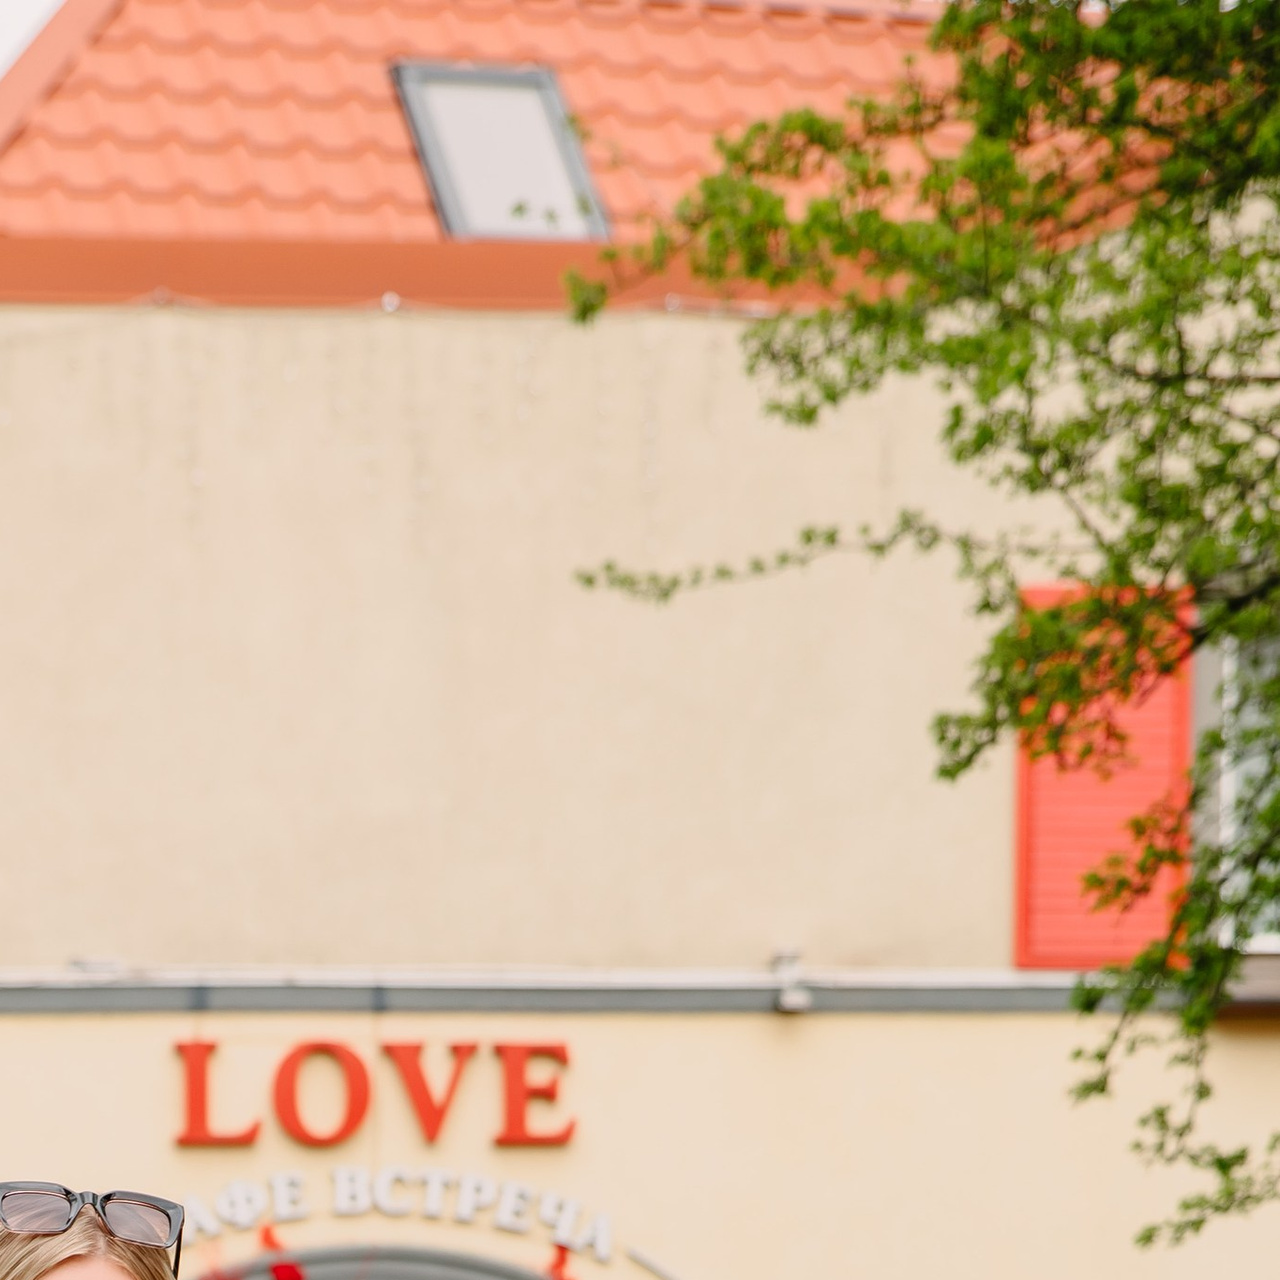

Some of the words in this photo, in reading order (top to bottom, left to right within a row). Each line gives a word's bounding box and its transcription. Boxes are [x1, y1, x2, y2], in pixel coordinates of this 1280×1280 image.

[173, 1040, 578, 1148] LOVE
[181, 1170, 309, 1247] АФЕ
[331, 1164, 612, 1263] ВСТРЕЧА
